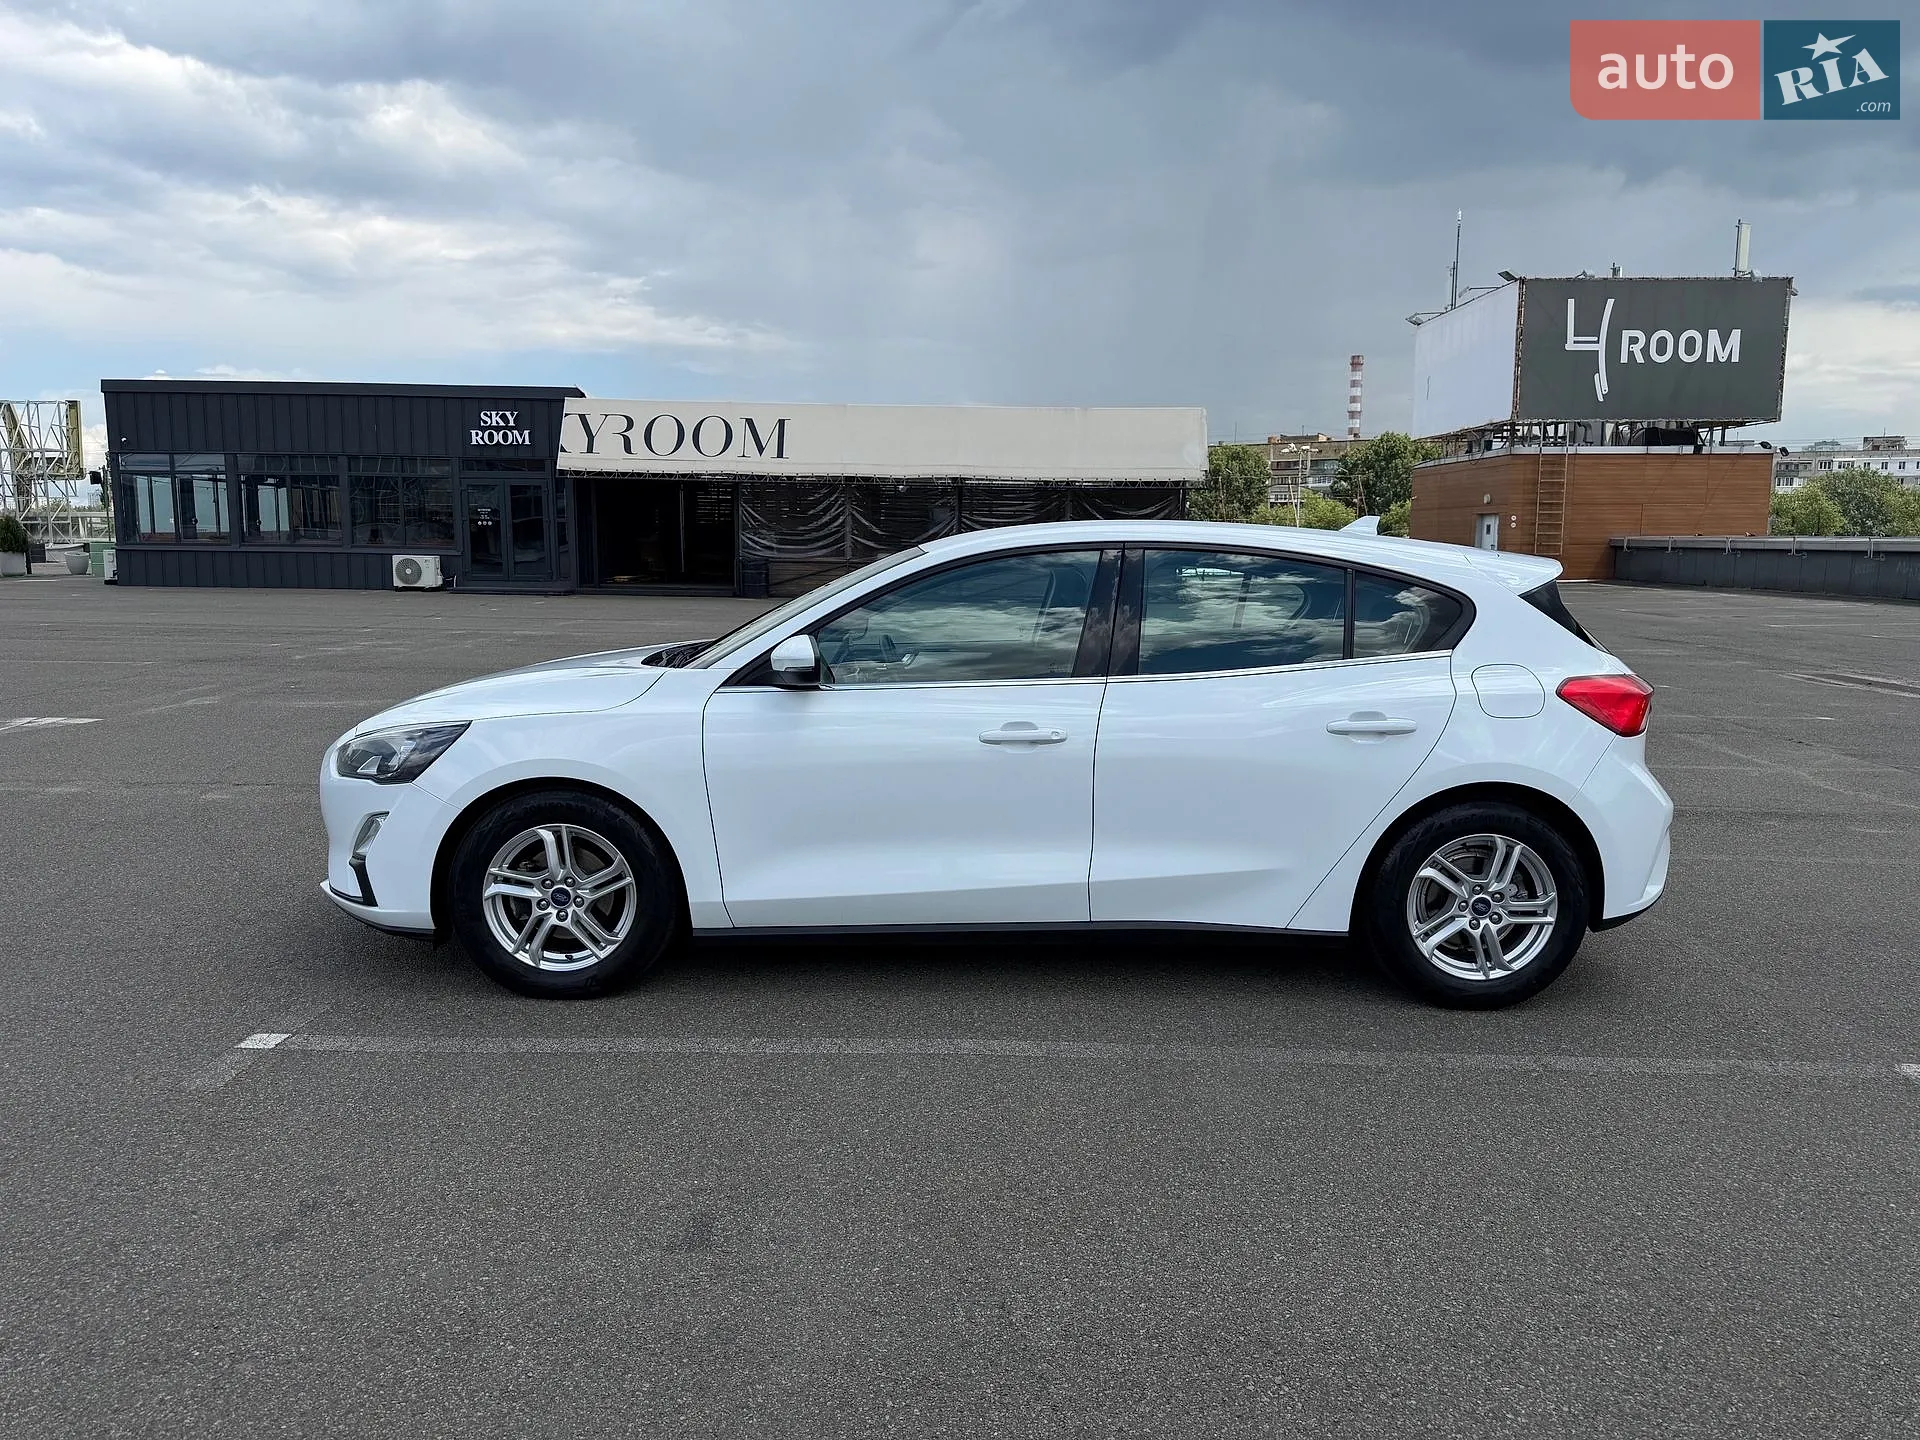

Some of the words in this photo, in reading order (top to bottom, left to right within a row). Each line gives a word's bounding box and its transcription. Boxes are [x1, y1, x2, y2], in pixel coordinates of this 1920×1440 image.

[1620, 328, 1742, 364] ROOM
[480, 410, 518, 427] SKY
[469, 429, 531, 446] ROOM
